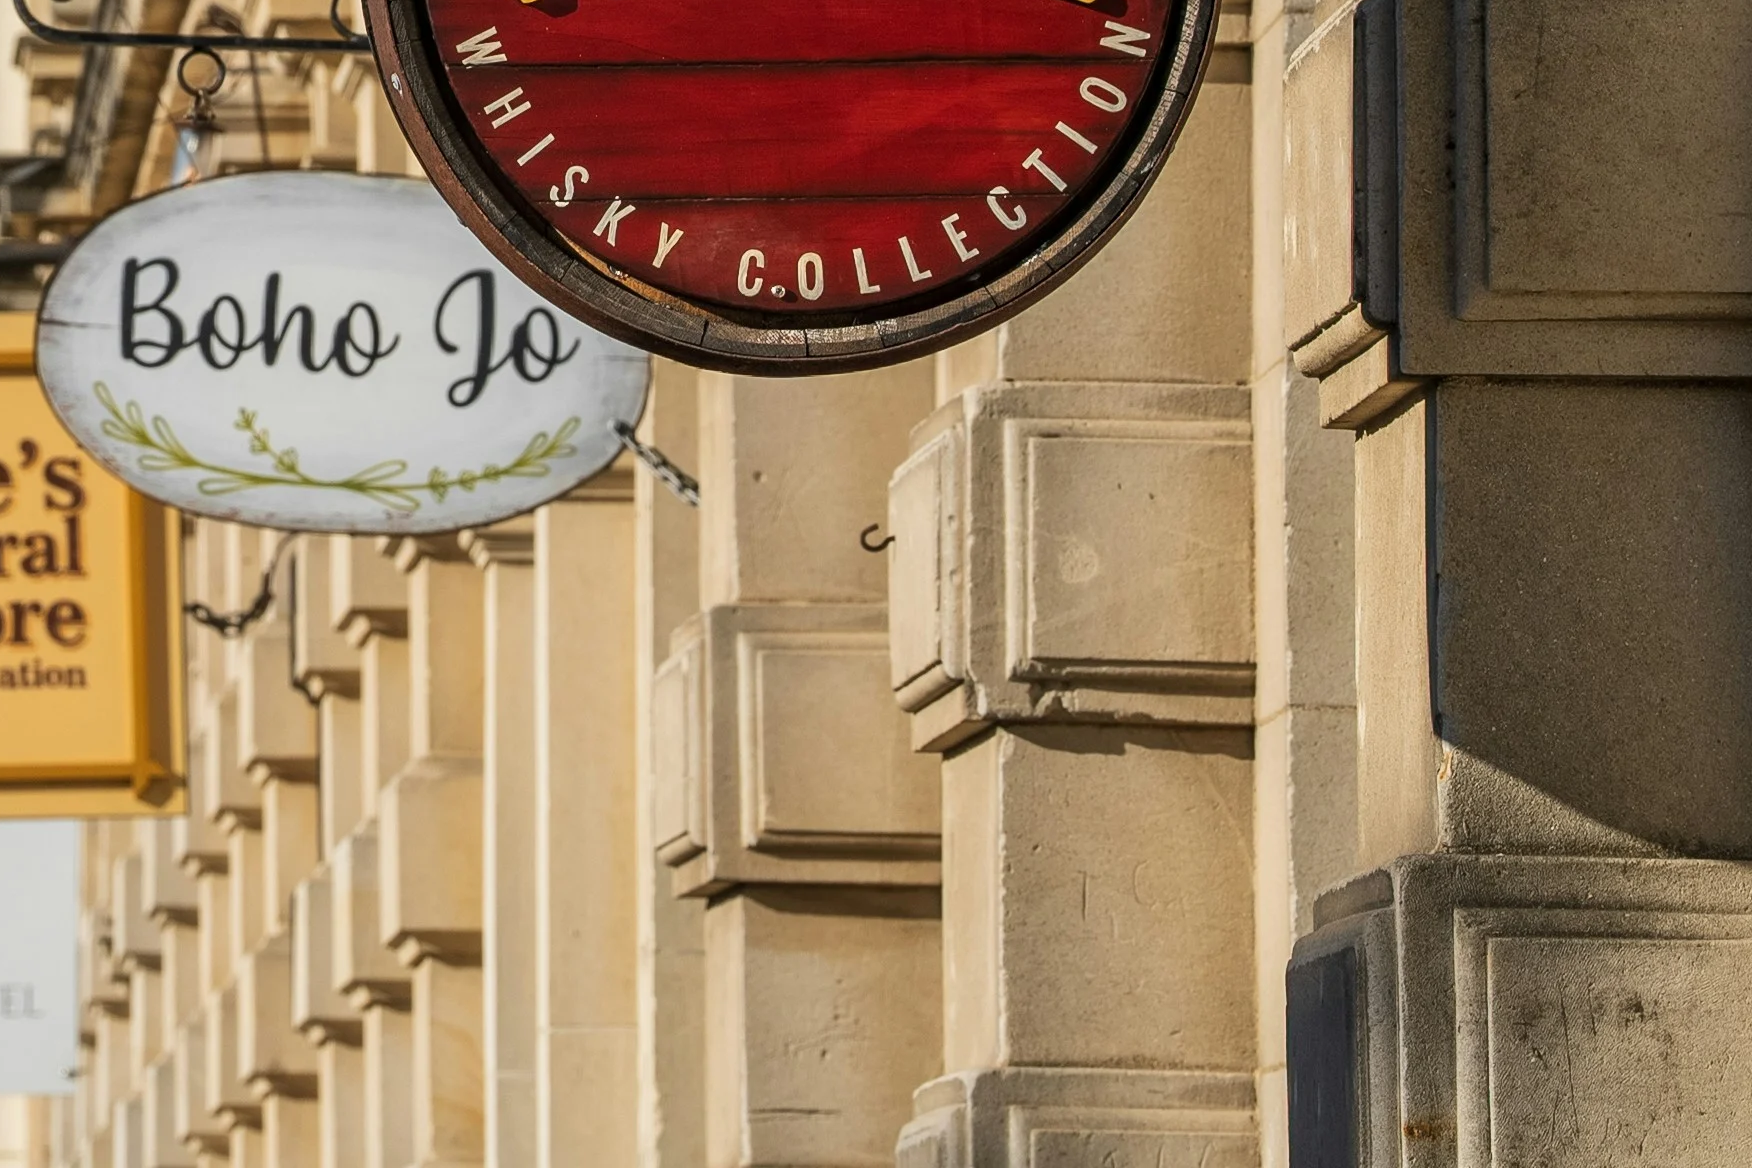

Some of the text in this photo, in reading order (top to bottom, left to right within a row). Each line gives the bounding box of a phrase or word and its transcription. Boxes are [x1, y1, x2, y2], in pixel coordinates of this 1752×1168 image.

[456, 20, 1152, 300] WHISKY COLLECTION
[121, 257, 581, 407] Boho Jo
